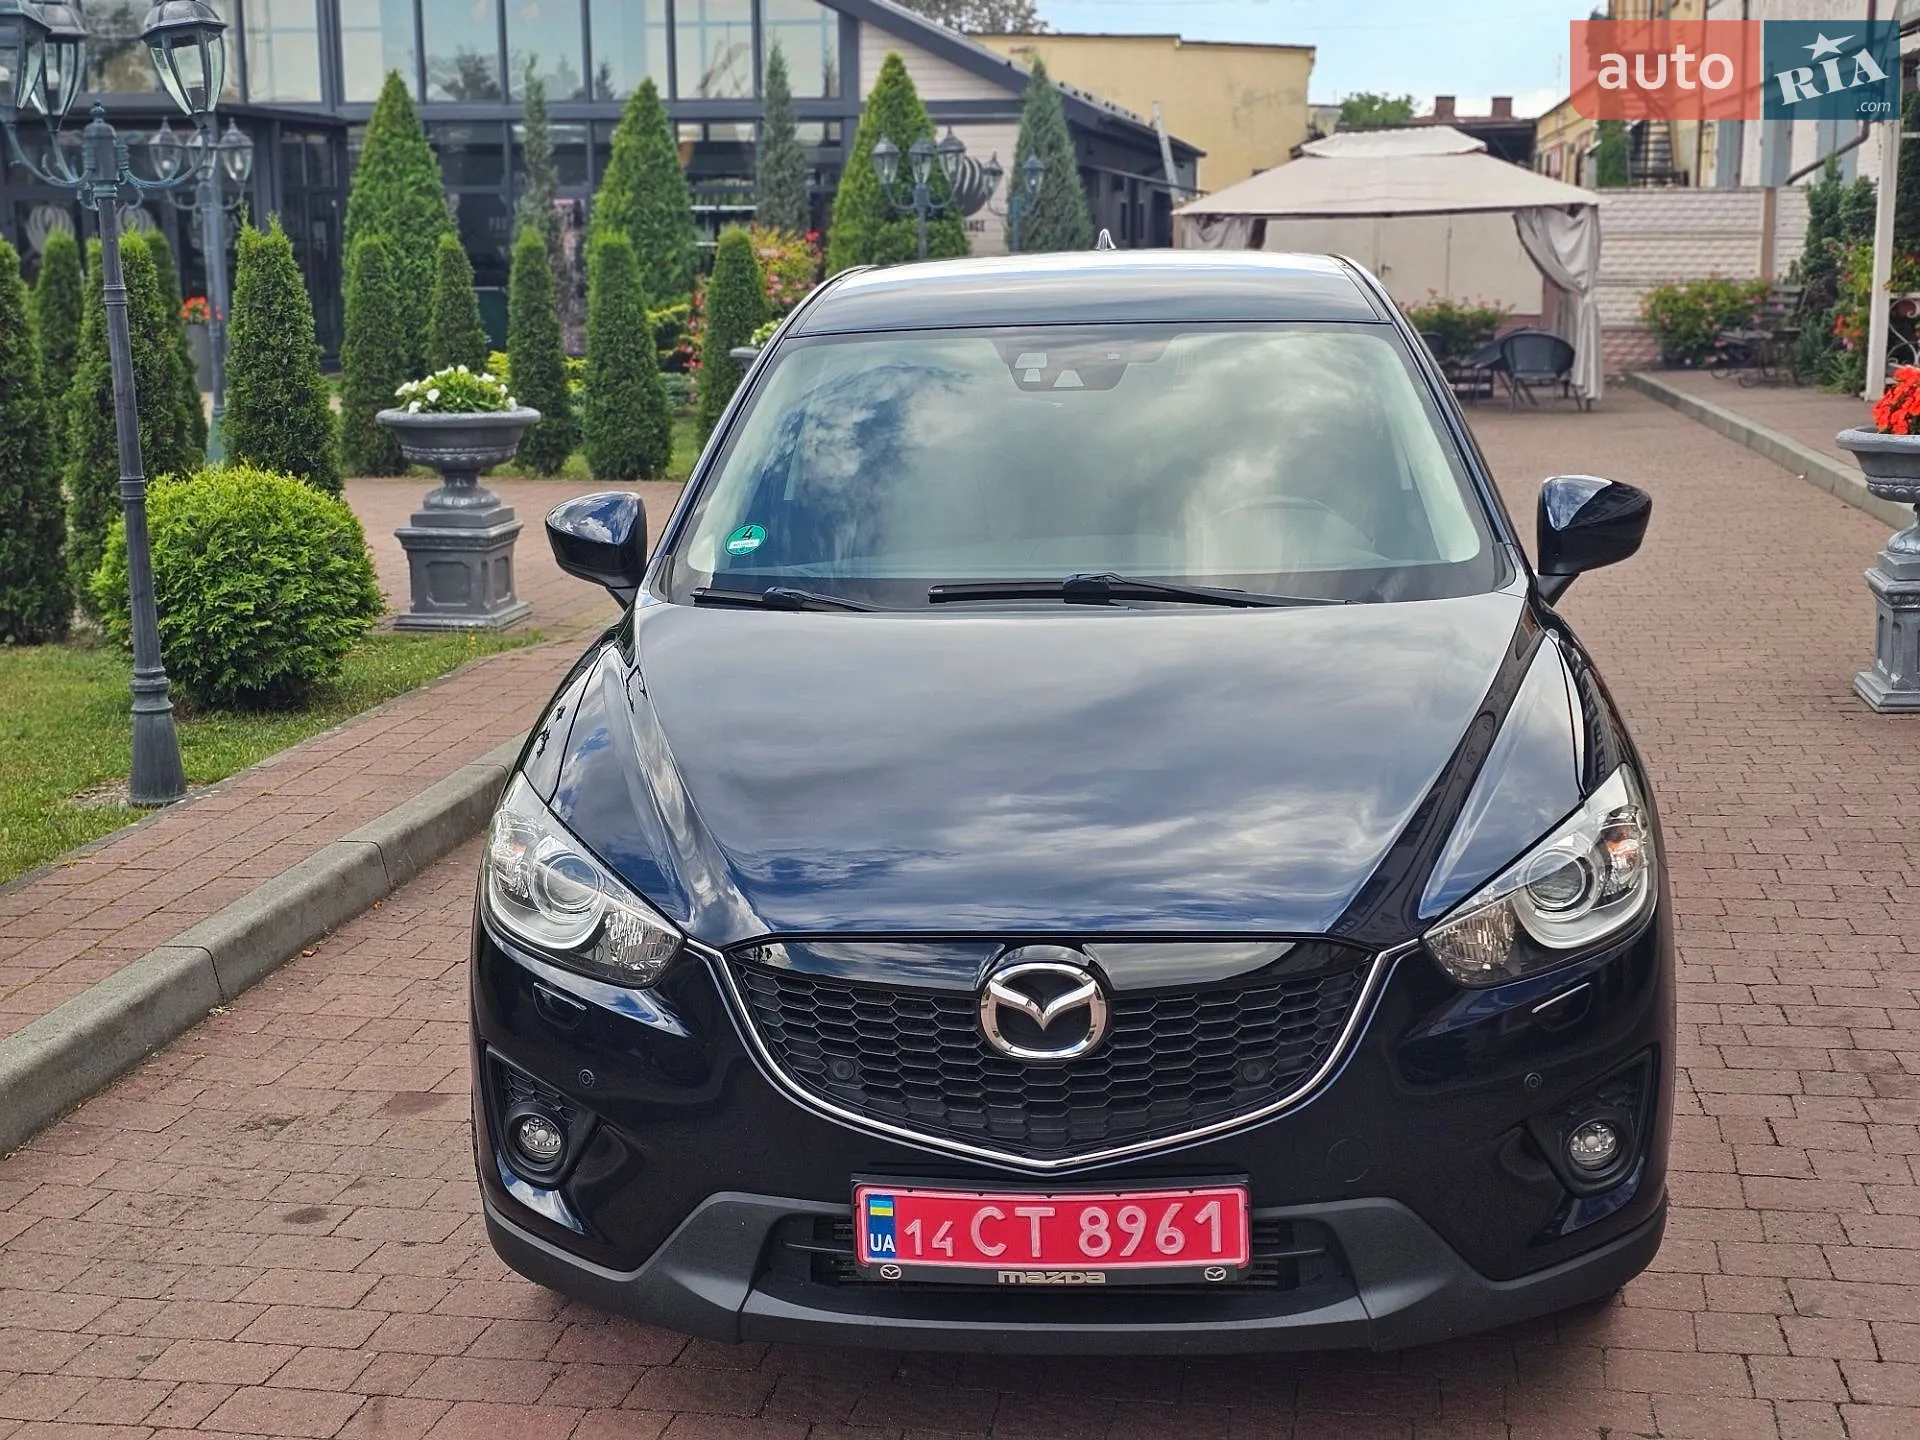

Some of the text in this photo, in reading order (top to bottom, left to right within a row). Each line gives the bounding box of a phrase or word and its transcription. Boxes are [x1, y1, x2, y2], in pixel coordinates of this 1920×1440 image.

[742, 526, 753, 540] 4
[903, 1200, 1223, 1258] 14 CT 8961
[870, 1233, 896, 1253] UA
